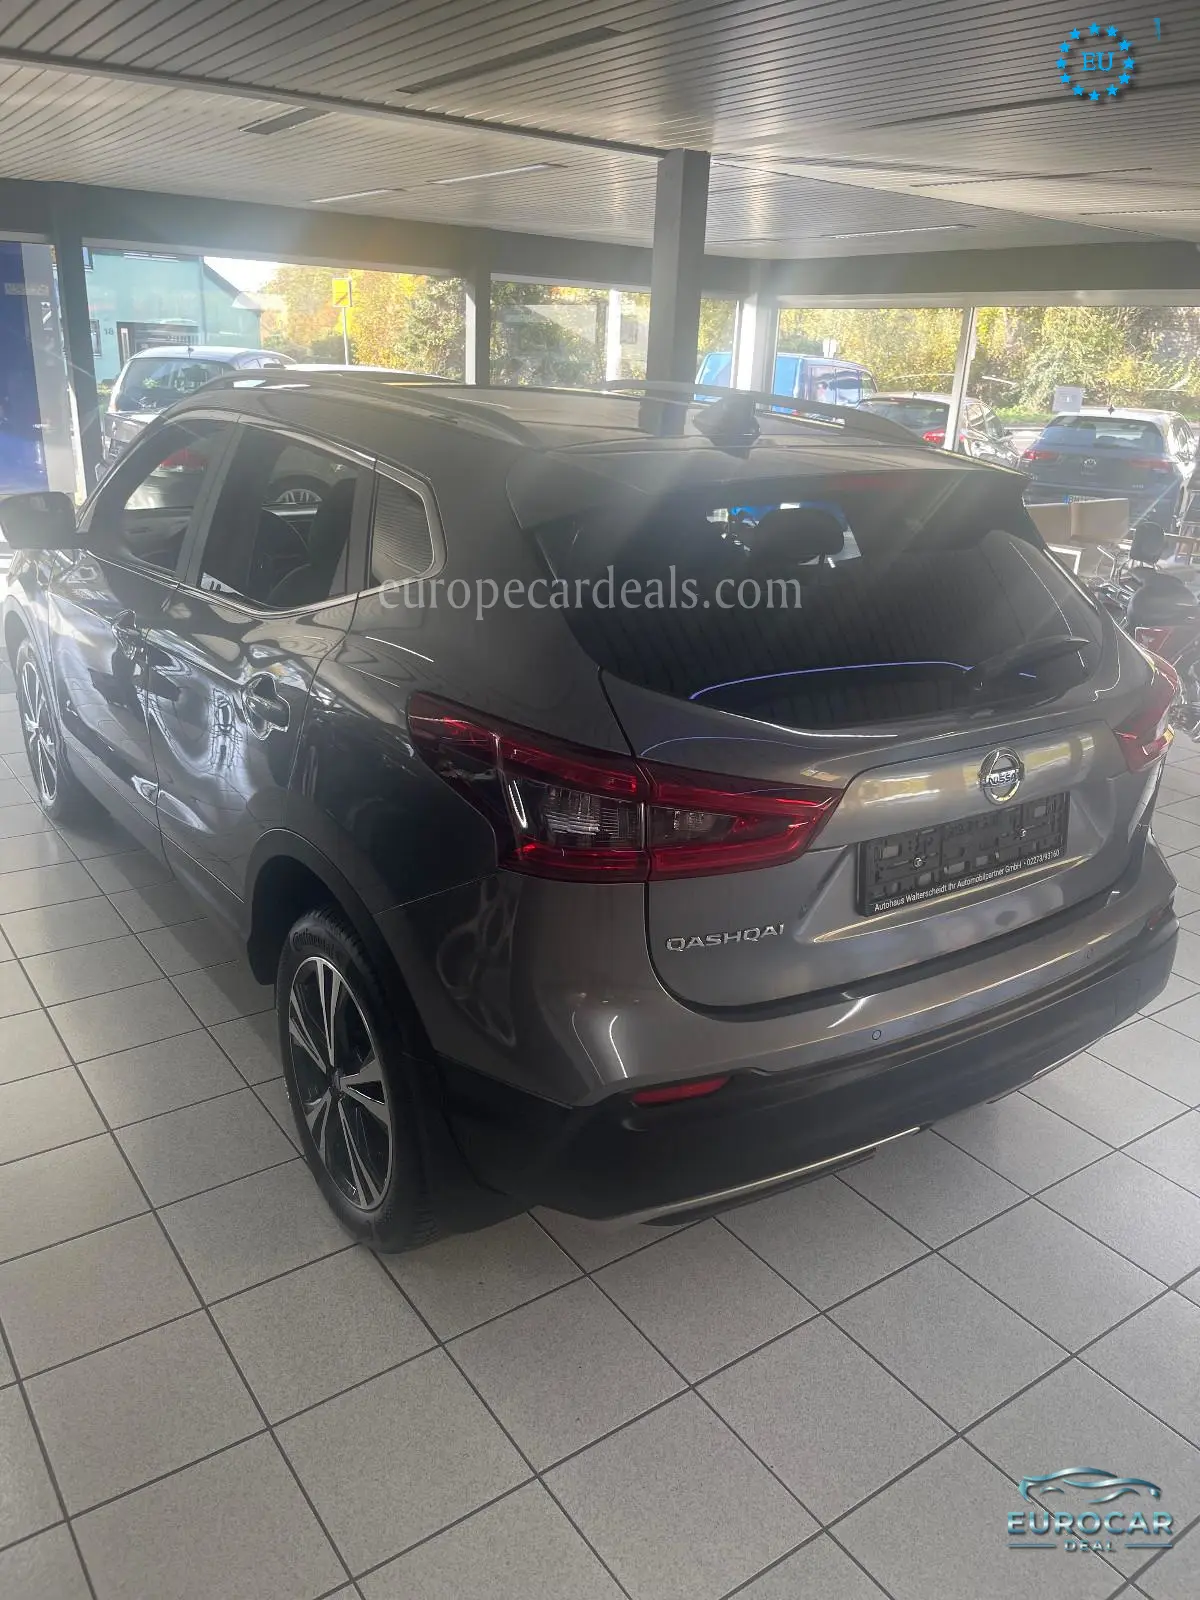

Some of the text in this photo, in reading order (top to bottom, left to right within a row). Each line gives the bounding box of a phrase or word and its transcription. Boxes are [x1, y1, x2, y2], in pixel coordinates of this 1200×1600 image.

[874, 897, 905, 912] Autohaus
[906, 884, 947, 903] Walterscheidt
[957, 868, 1005, 888] Automobilpartner
[1005, 861, 1022, 874] GmbH
[666, 922, 785, 952] QASHQAI
